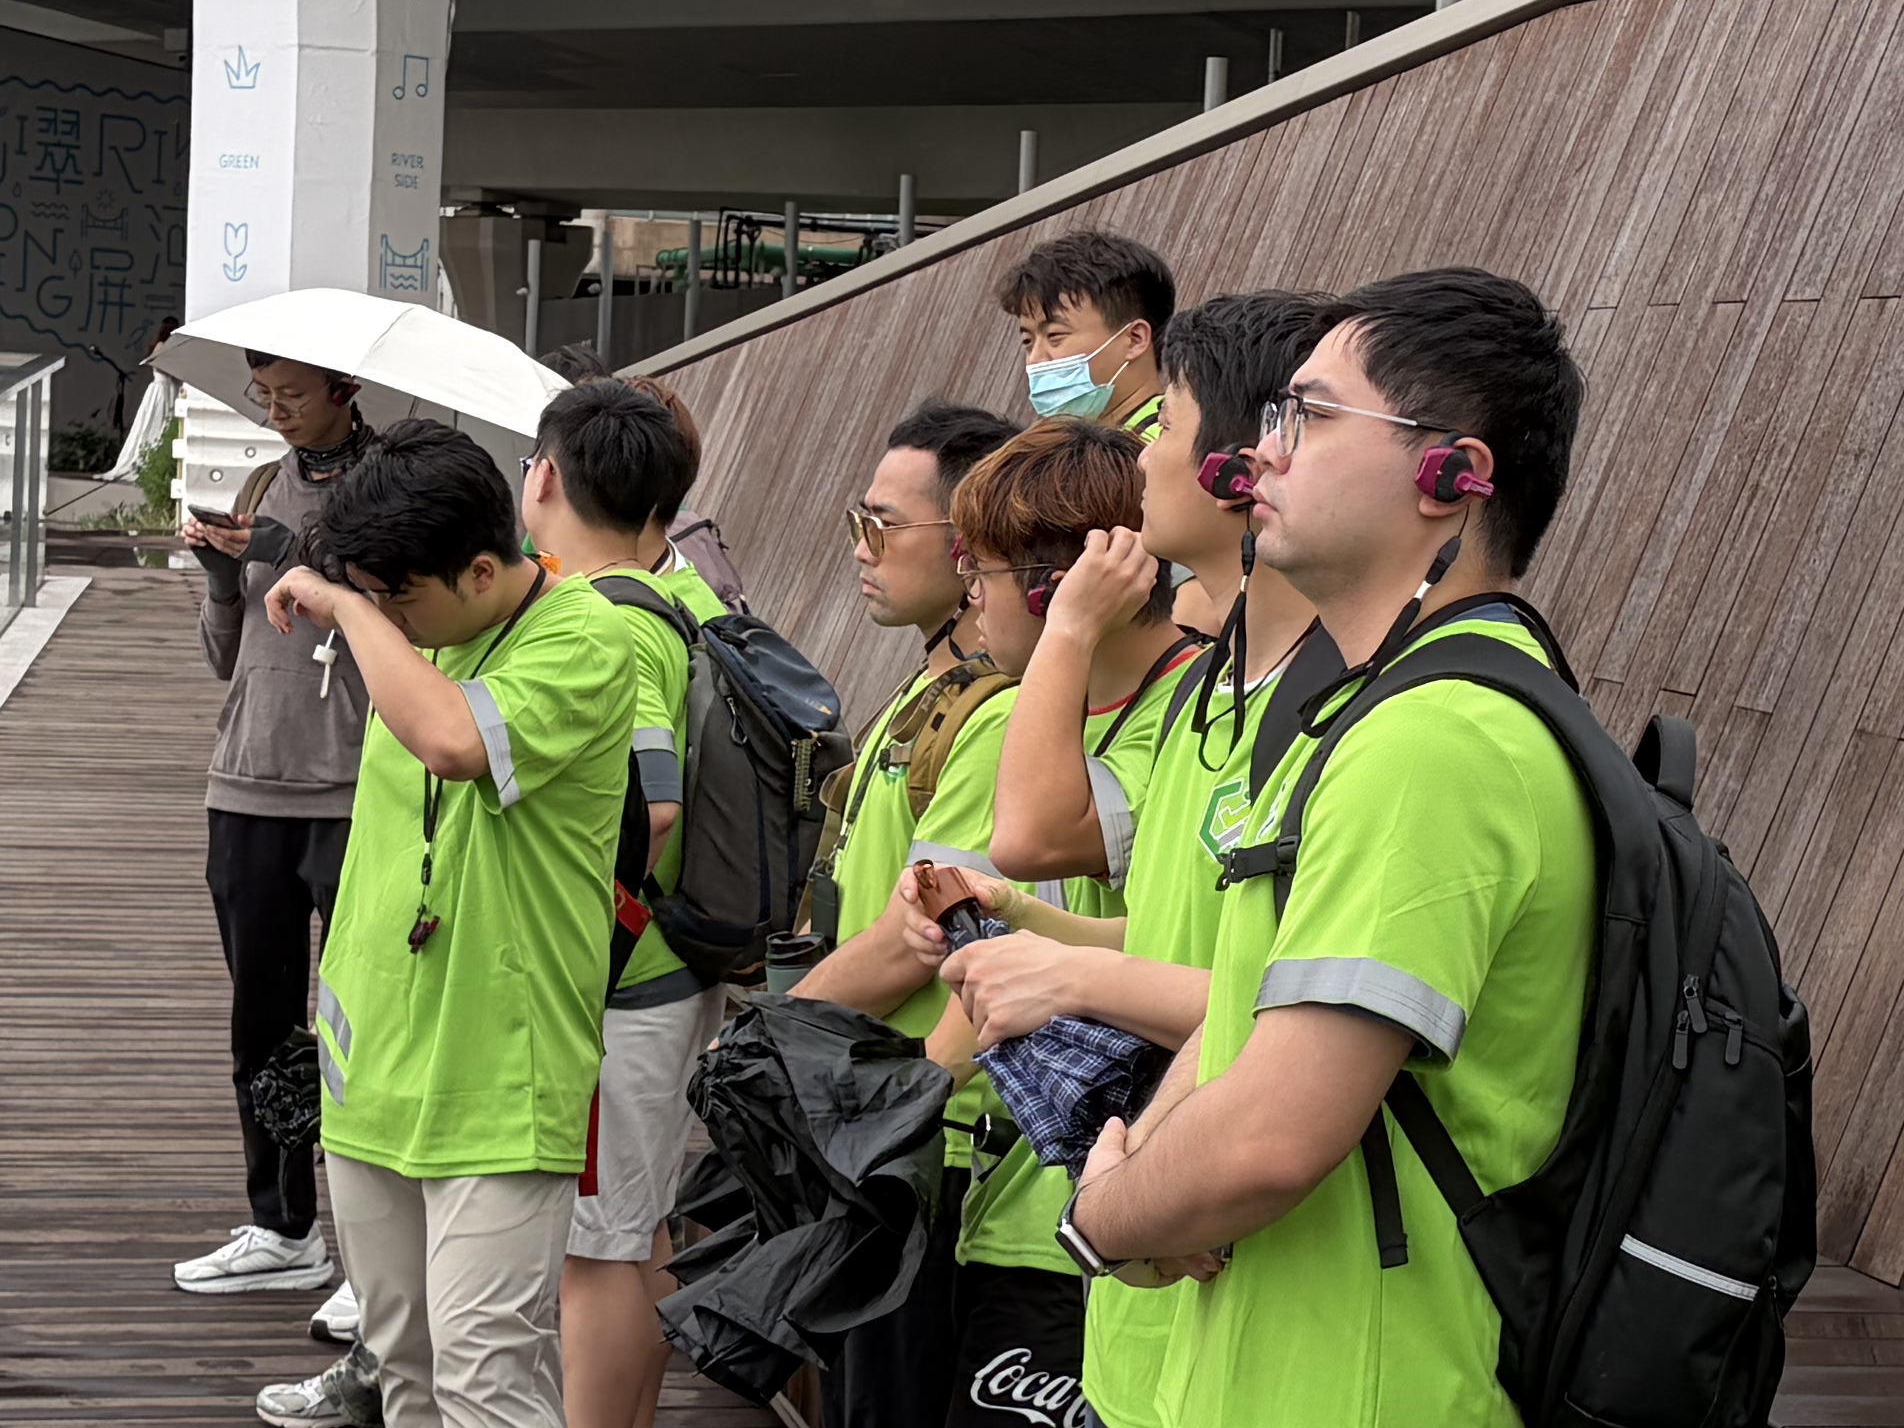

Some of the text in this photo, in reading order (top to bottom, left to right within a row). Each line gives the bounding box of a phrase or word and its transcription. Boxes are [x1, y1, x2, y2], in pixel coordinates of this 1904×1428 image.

[28, 105, 85, 196] 翠
[219, 153, 260, 169] GREEN
[391, 152, 424, 169] RIVER
[394, 173, 418, 189] SIDE
[77, 247, 136, 335] 屏
